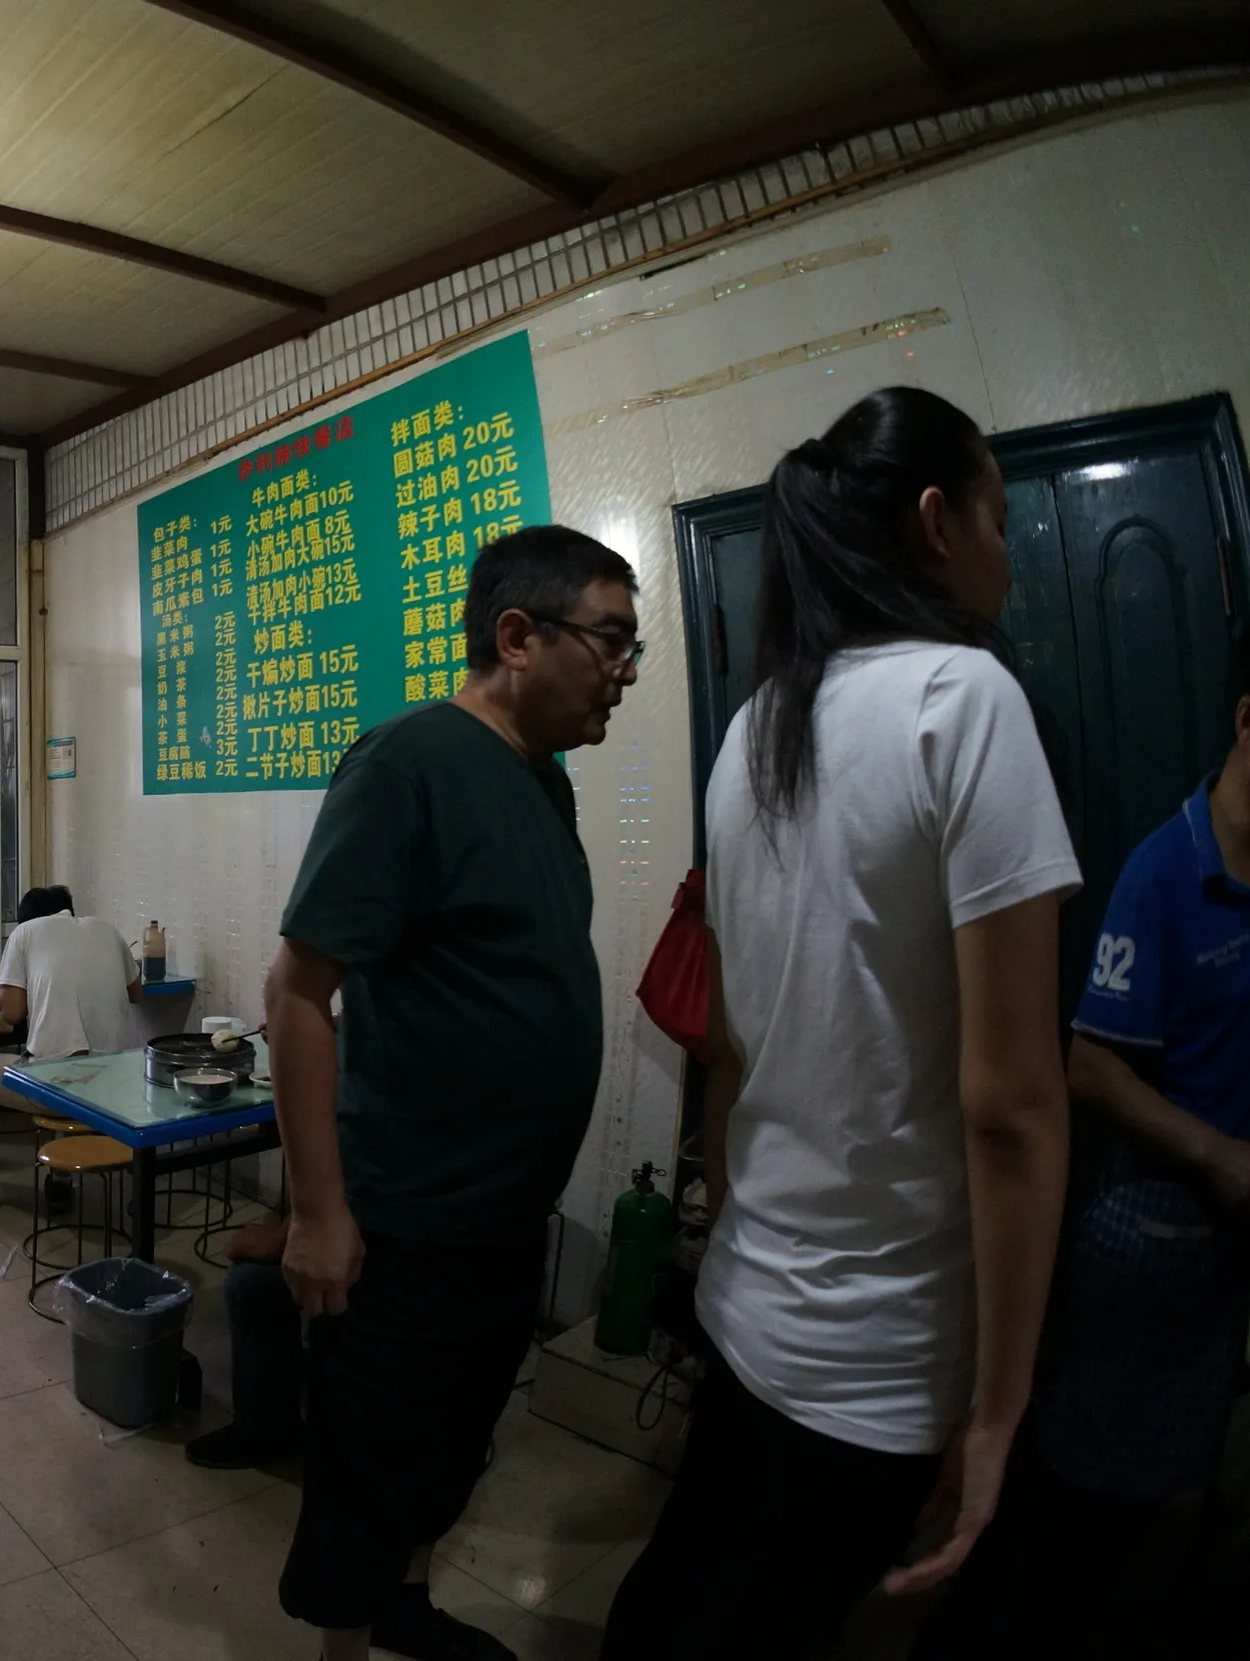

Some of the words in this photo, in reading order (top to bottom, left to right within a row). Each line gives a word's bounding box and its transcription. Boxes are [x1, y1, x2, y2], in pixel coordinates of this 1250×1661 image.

[393, 432, 456, 479] 圆菇肉
[462, 411, 514, 450] 20元
[396, 464, 460, 508] 过油肉
[466, 445, 518, 483] 20元
[398, 497, 463, 540] 辣子肉
[470, 479, 522, 515] 18元
[210, 514, 233, 534] 1元
[210, 539, 232, 558] 1元
[400, 530, 466, 570] 木耳肉
[210, 558, 233, 577] 1元
[211, 578, 233, 597] 1元
[402, 563, 469, 604] 土豆丝
[214, 611, 236, 630] 2元
[215, 628, 236, 646] 2元
[215, 648, 237, 666] 2元
[319, 644, 359, 674] 15元
[215, 665, 237, 682] 2元
[216, 683, 238, 701] 2元
[216, 701, 238, 719] 2元
[216, 718, 238, 736] 2元
[321, 717, 360, 745] 13元
[216, 736, 238, 756] 3元
[215, 758, 238, 777] 2元
[245, 748, 347, 780] 二节子炒面13
[1092, 932, 1136, 993] 92
